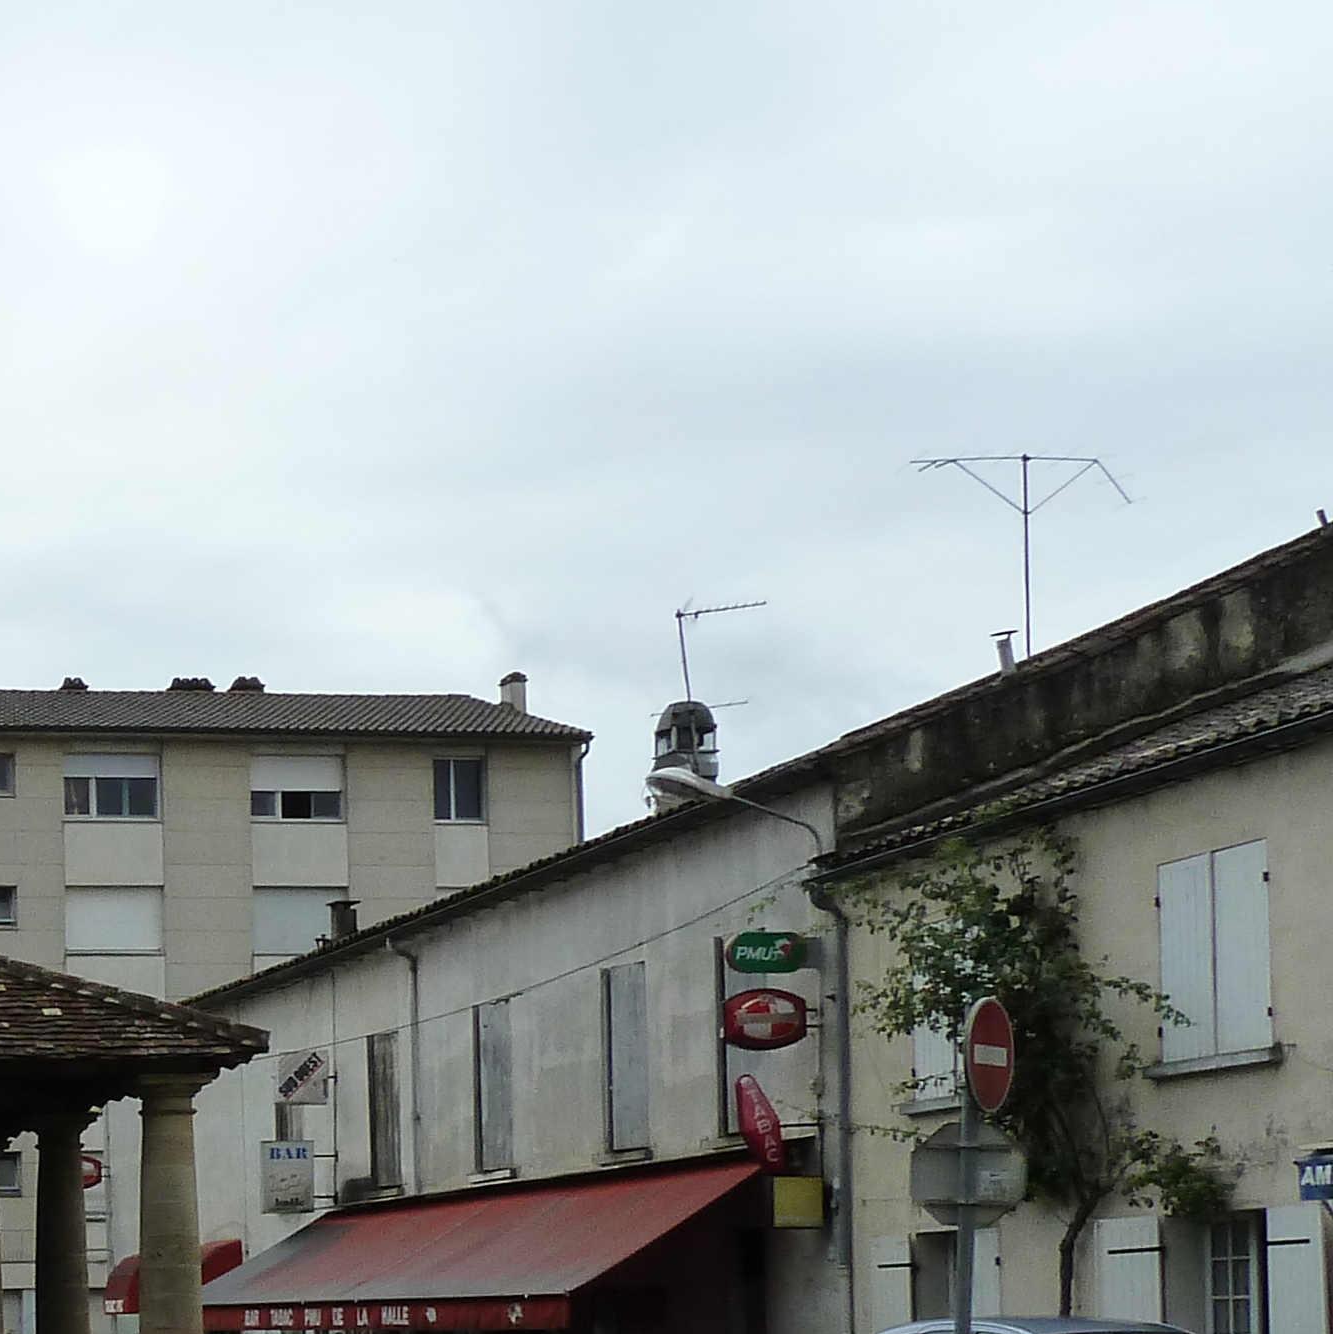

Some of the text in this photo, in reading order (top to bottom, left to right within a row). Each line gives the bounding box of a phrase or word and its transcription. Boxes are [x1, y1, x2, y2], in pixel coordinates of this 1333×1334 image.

[736, 946, 773, 961] PMU
[278, 1052, 323, 1098] SUD OUEST
[746, 1089, 779, 1162] TABAC
[270, 1147, 308, 1160] BAR
[244, 1305, 410, 1326] BAR TABAC PMU DE LA HALLE
